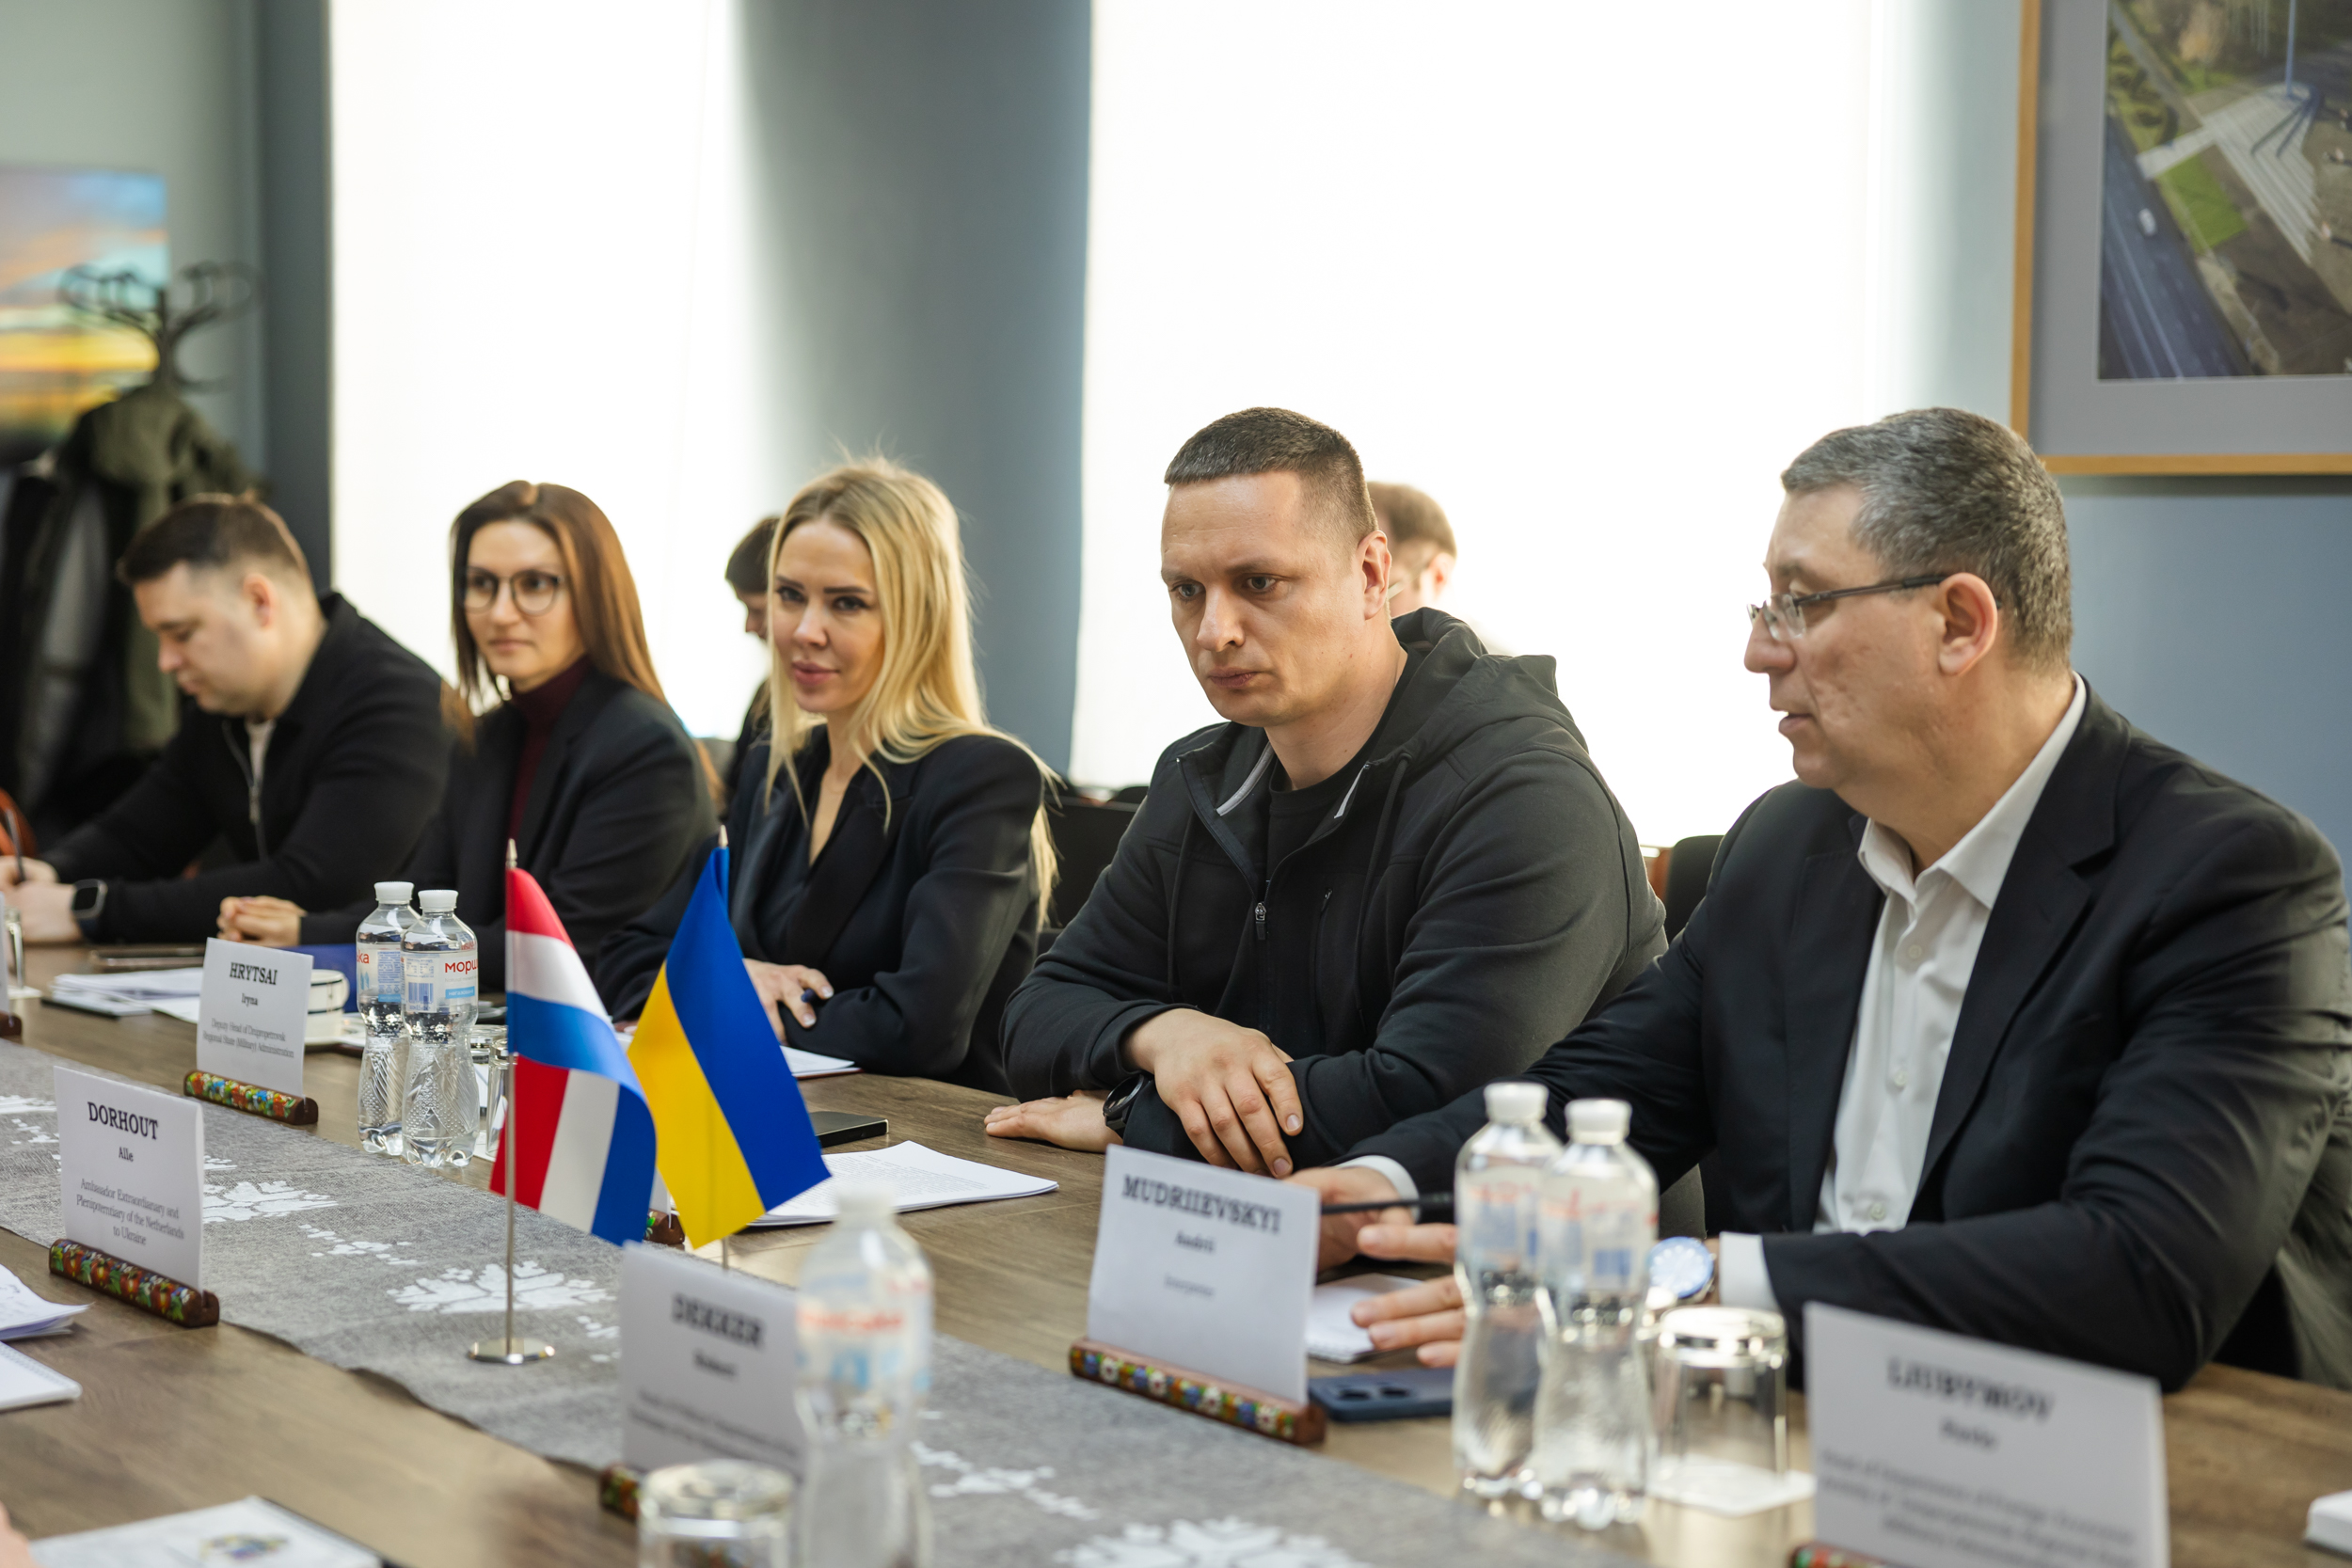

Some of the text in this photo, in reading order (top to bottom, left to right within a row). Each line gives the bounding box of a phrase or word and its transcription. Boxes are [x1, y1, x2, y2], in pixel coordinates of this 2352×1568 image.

[229, 961, 278, 986] HRYTSAI
[241, 992, 259, 1007] Iryna
[211, 1018, 229, 1032] Deputy
[230, 1021, 242, 1033] Head
[242, 1024, 247, 1034] of
[202, 1030, 222, 1044] Regional
[222, 1035, 235, 1046] State
[258, 1042, 294, 1058] Administration
[87, 1101, 158, 1141] DORHOUT
[118, 1146, 134, 1163] Alle
[167, 1207, 180, 1219] and
[1121, 1174, 1281, 1234] MUDRIIEVSKYI
[113, 1226, 147, 1245] to Ukraine
[126, 1211, 134, 1223] of
[134, 1212, 145, 1227] the
[145, 1215, 184, 1240] Netherlands
